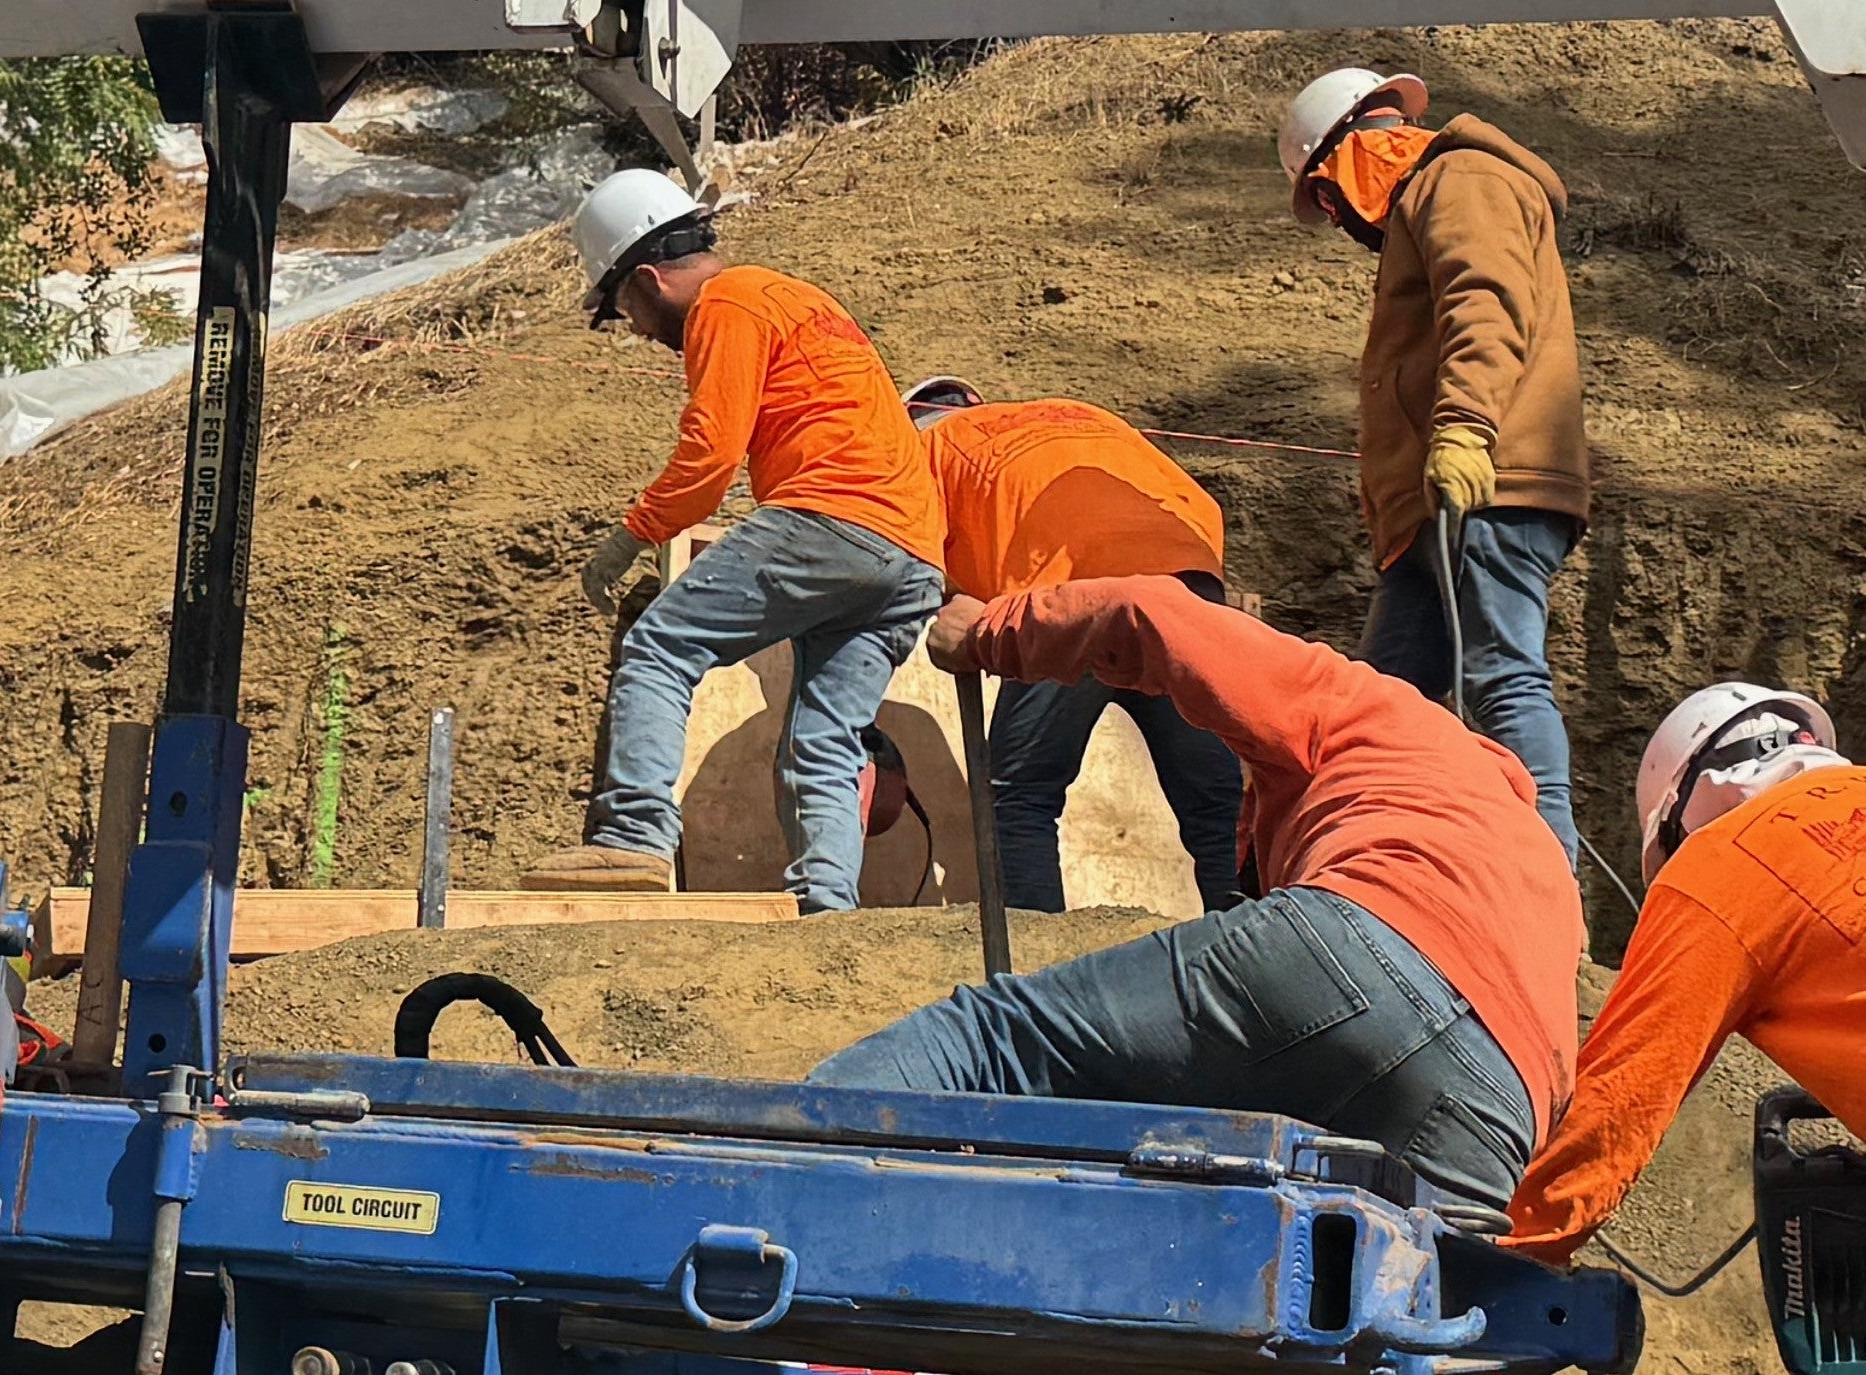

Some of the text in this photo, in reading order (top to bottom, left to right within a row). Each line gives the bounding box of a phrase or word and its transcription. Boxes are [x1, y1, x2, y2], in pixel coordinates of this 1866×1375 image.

[203, 322, 229, 411] REMOVE
[200, 416, 221, 459] FOR
[302, 1193, 422, 1220] TOOL CIRCUIT
